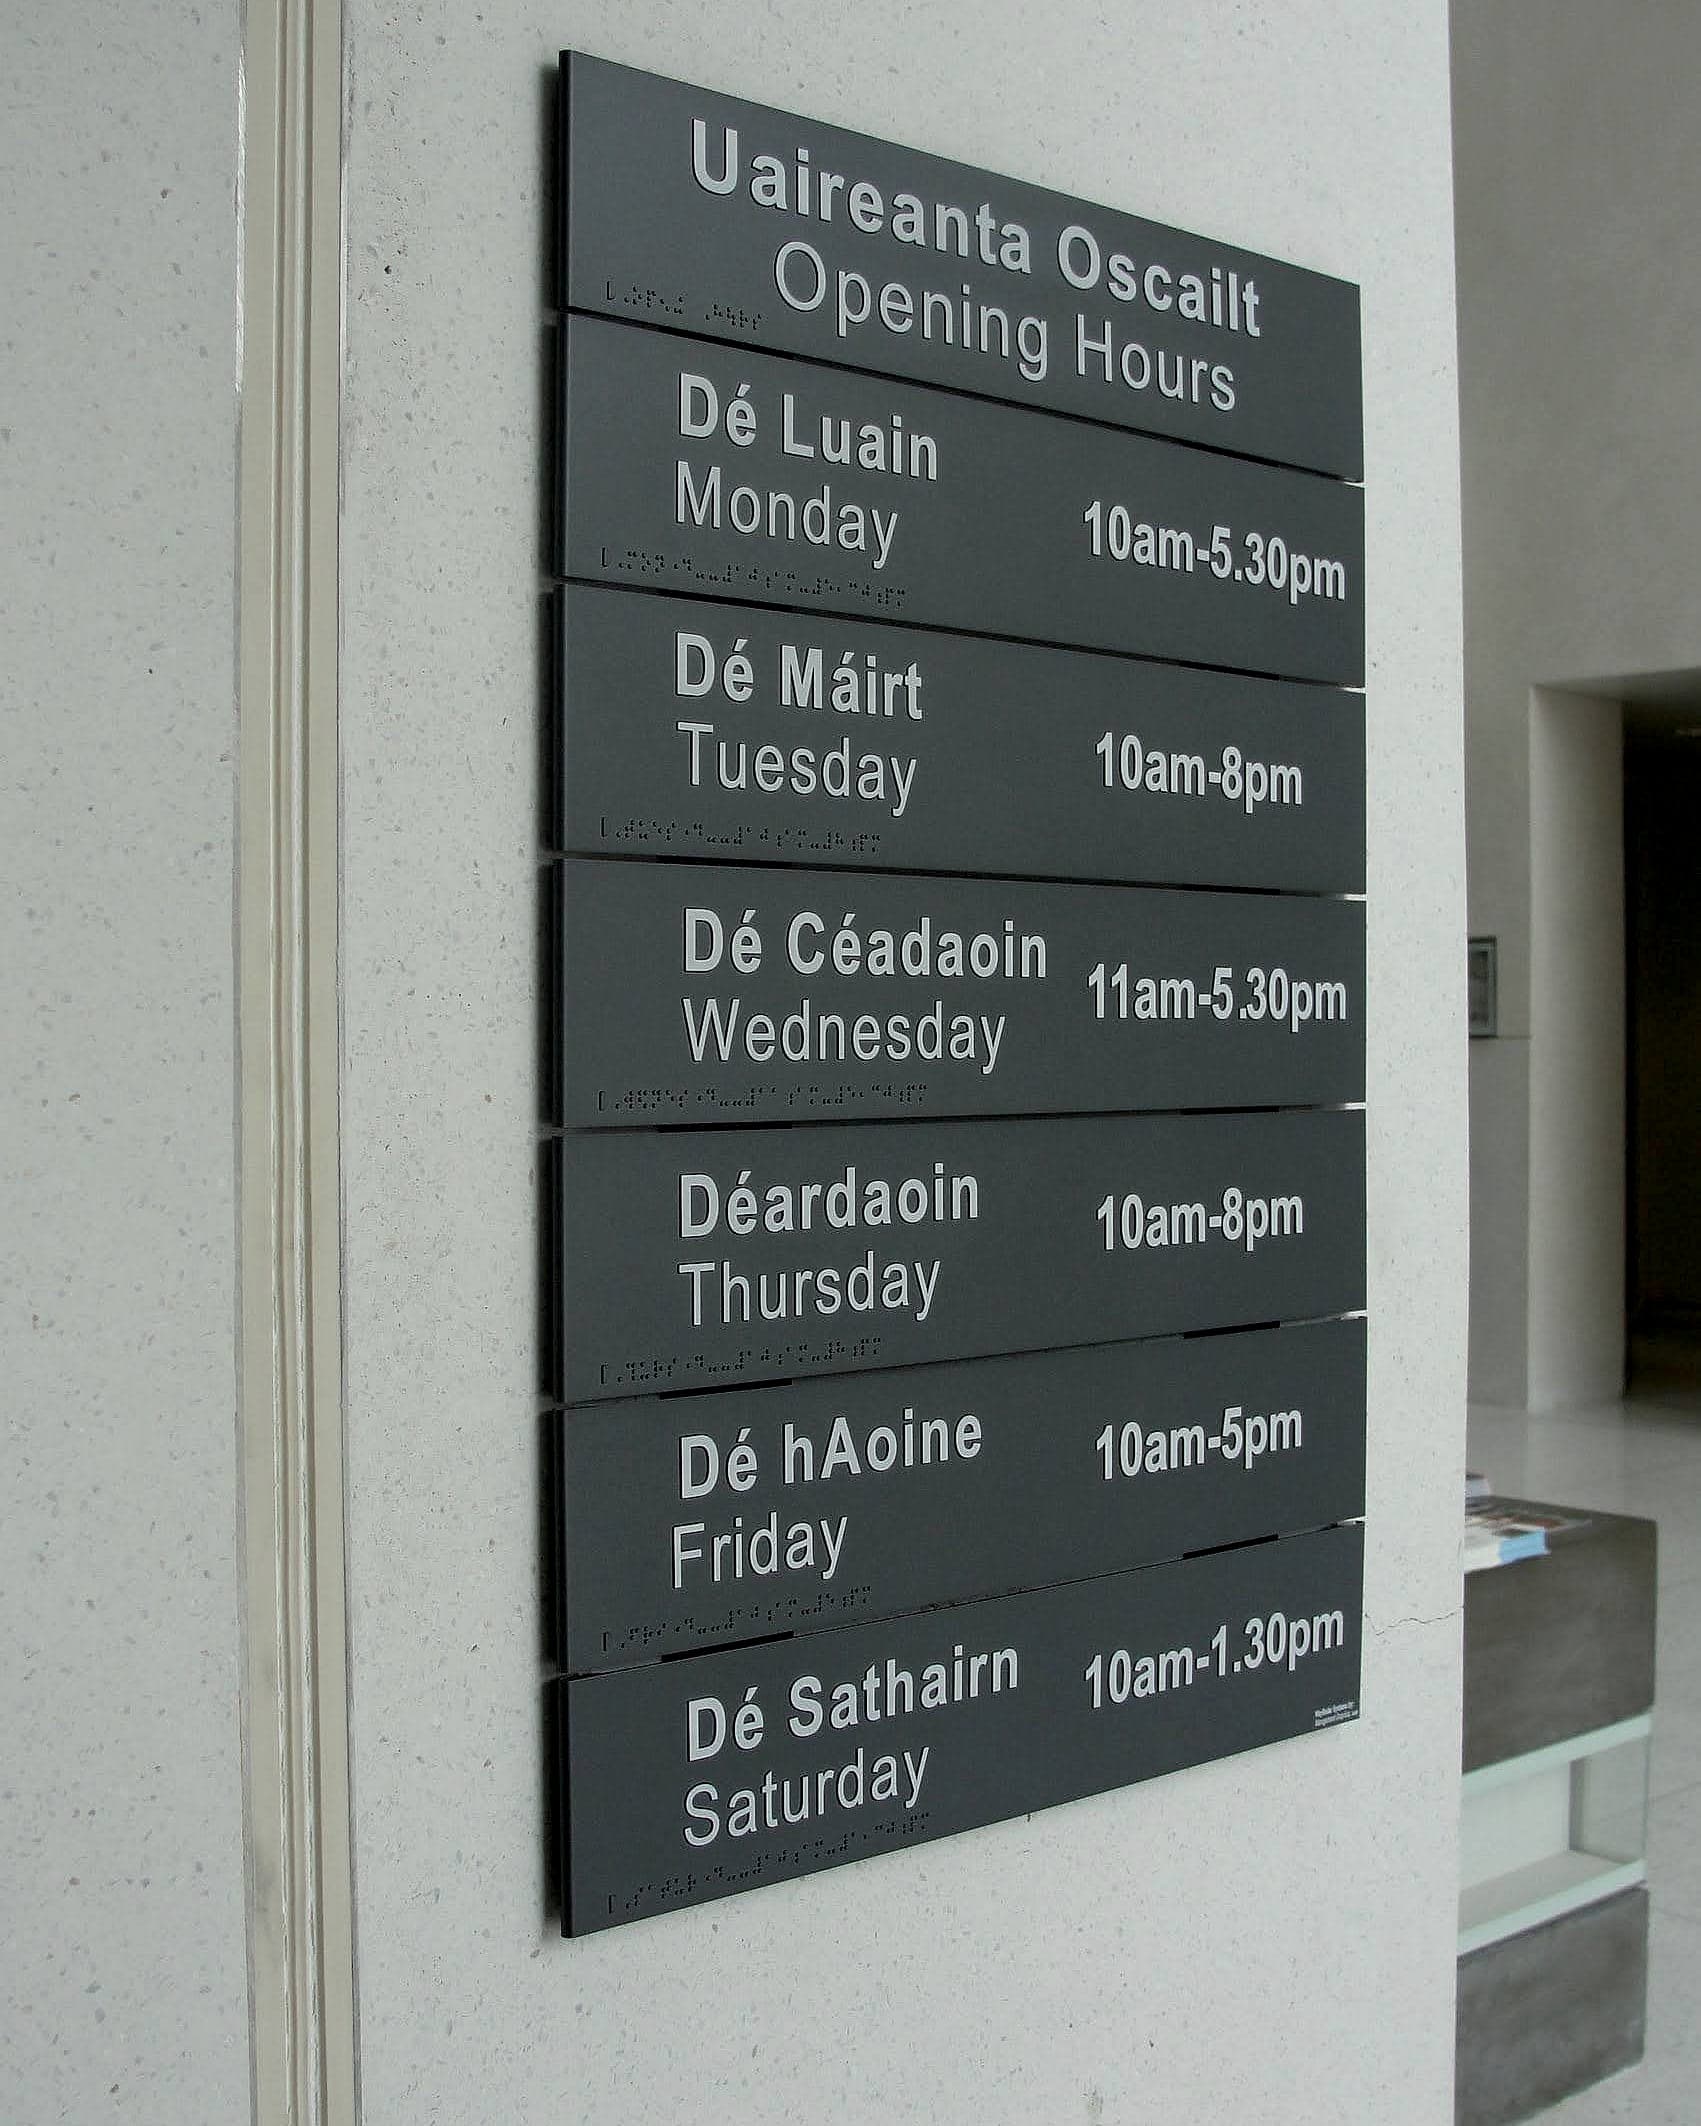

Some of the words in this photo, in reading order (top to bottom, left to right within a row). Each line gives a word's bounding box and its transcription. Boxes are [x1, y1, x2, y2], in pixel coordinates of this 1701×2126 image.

[693, 118, 1032, 274] Uaireanta
[1058, 225, 1261, 338] Oscailt
[775, 241, 1048, 382] Opening
[1077, 313, 1236, 411] Hours
[680, 371, 757, 447] Dé
[783, 393, 937, 481] Luain
[677, 460, 899, 570] Monday
[1084, 500, 1346, 605] 10am-5.30pm
[677, 631, 754, 702] Dé
[781, 644, 923, 720] Máirt
[677, 721, 917, 817] Tuesday
[1096, 731, 1303, 814] 10am-8pm
[685, 908, 762, 974] Dé
[787, 911, 1046, 978] Céadaoin
[682, 998, 1006, 1075] Wednesday
[1088, 963, 1347, 1033] 11am-5.30pm
[680, 1162, 979, 1238] Déardaoin
[1097, 1187, 1304, 1252] 10am-8pm
[678, 1250, 941, 1326] Thursday
[681, 1427, 758, 1499] Dé
[784, 1407, 982, 1484] hAoine
[1096, 1406, 1302, 1480] 10am-5pm
[673, 1511, 848, 1589] Friday
[688, 1686, 764, 1762] Dé
[789, 1644, 1018, 1737] Sathairn
[1085, 1610, 1344, 1709] 10am-1.30pm
[684, 1746, 930, 1846] Saturday
